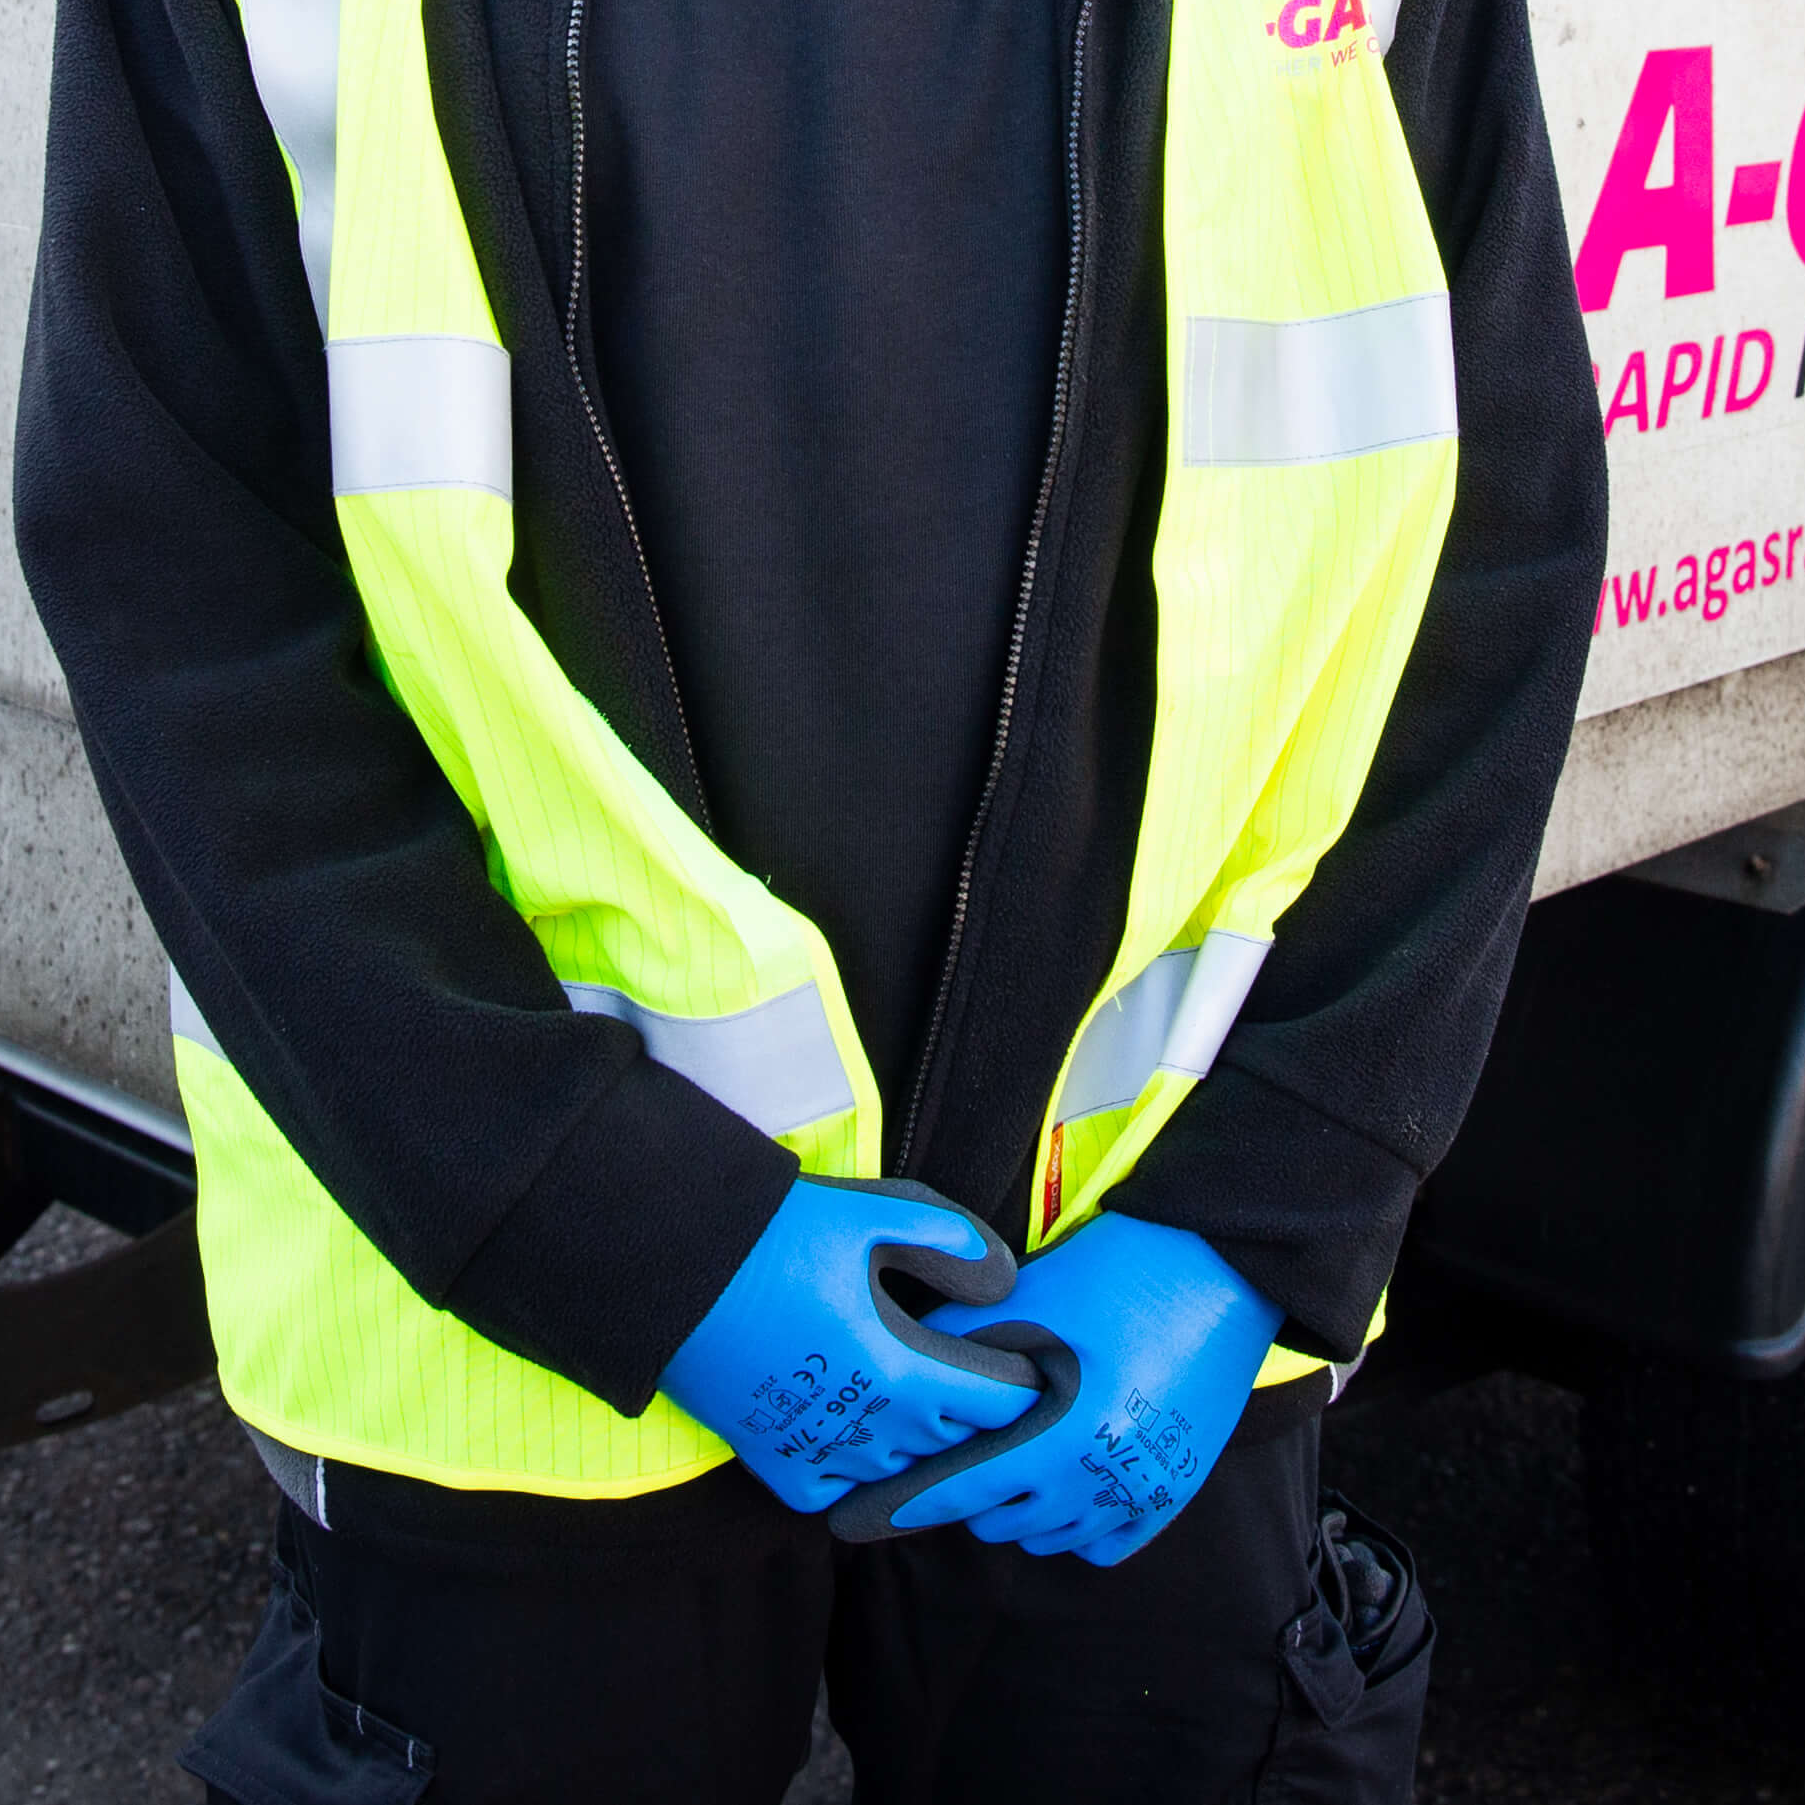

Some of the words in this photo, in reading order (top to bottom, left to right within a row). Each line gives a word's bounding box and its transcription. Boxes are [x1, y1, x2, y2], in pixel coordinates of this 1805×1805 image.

[1591, 327, 1777, 442] APID
[750, 1373, 779, 1401] 2121X
[792, 1352, 828, 1390] CE
[809, 1384, 827, 1402] EN
[826, 1369, 874, 1417] 306
[805, 1395, 891, 1465] SHOWA
[1168, 1406, 1194, 1436] 2121X
[1093, 1421, 1141, 1474] 7/M
[1134, 1428, 1172, 1472] 388:2016
